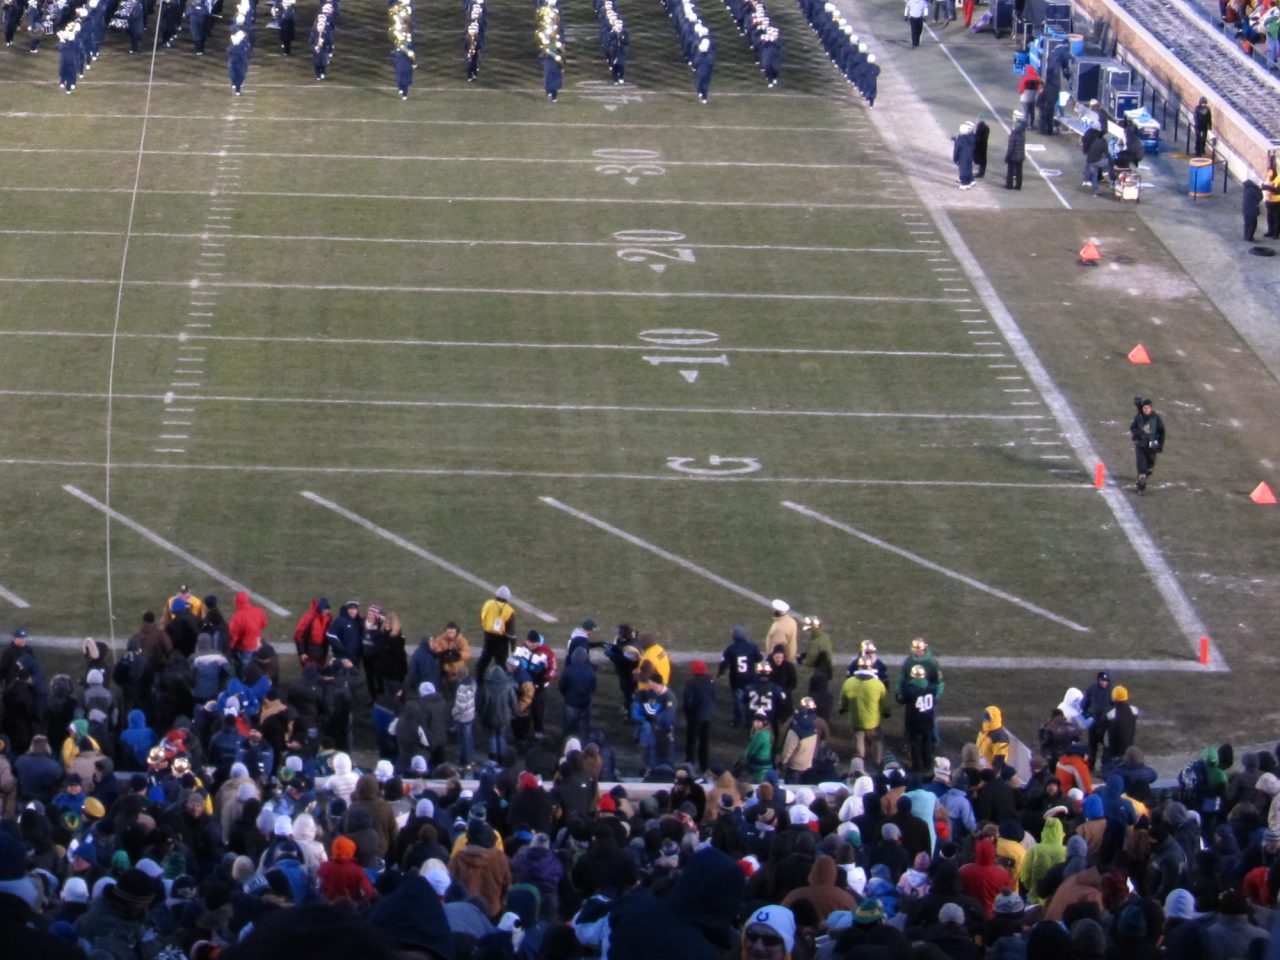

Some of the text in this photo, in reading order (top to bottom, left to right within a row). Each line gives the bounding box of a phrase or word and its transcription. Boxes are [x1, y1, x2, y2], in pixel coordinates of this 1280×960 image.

[592, 148, 667, 175] 30
[613, 229, 697, 264] 20
[637, 327, 731, 367] 10
[666, 454, 763, 475] G
[737, 656, 748, 673] 5
[915, 693, 934, 713] 40
